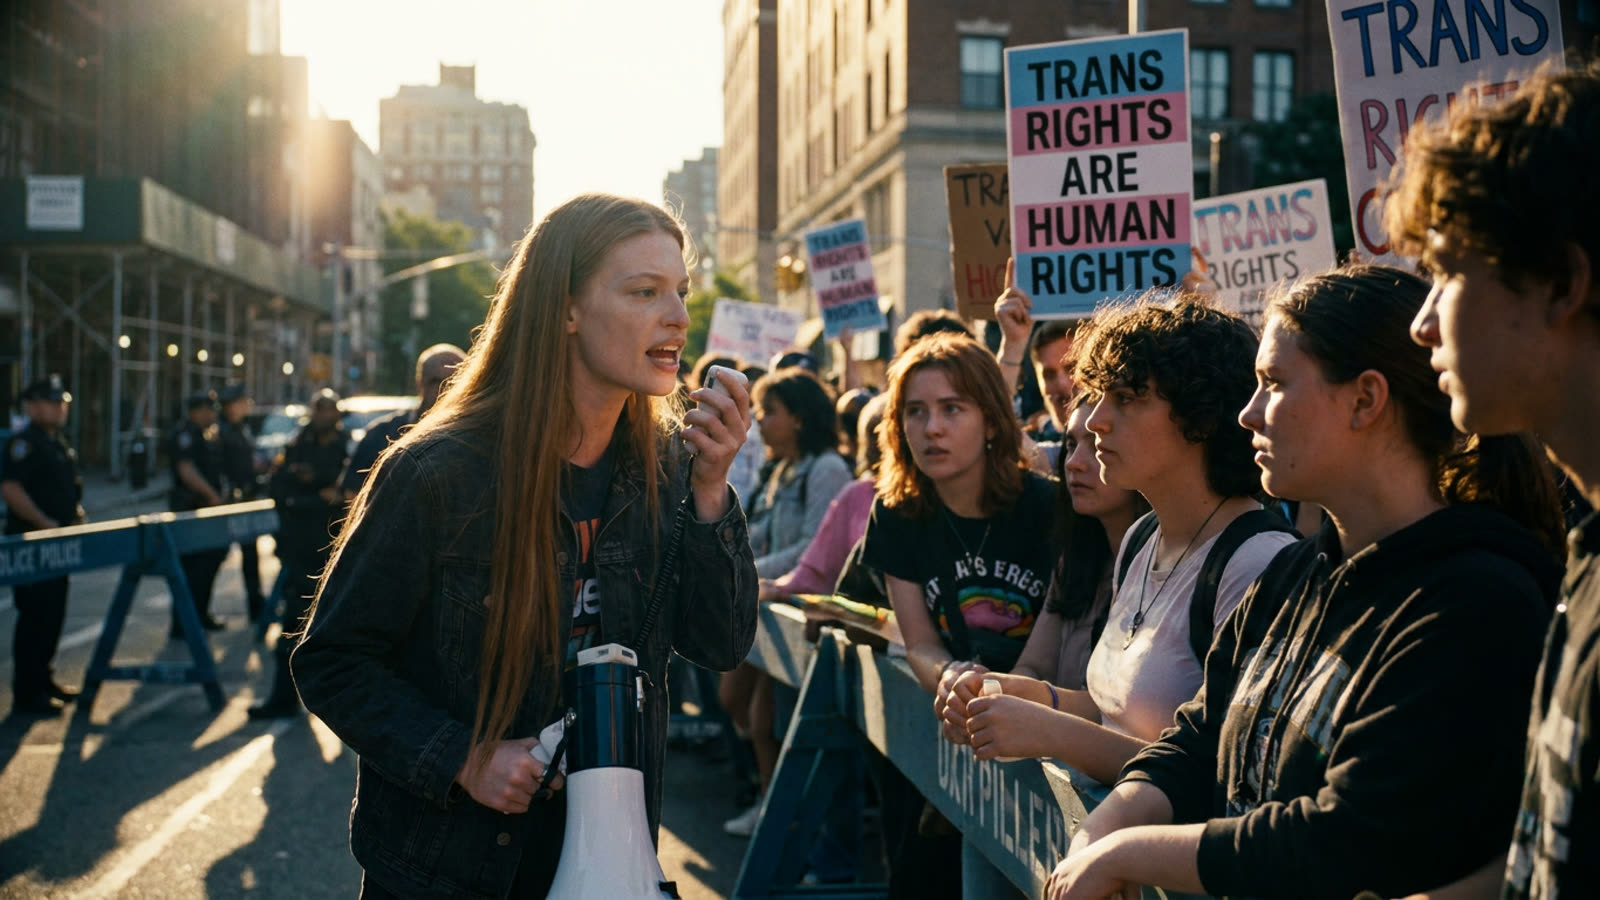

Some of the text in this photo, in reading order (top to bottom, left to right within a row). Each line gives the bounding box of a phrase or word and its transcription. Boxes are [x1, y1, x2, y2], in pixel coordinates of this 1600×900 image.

[1341, 0, 1549, 77] TRANS
[1027, 49, 1164, 102] TRANS
[1026, 98, 1172, 151] RIGHTS
[1060, 151, 1139, 197] ARE
[1028, 198, 1176, 248] HUMAN
[1193, 188, 1318, 257] TRANS
[1031, 247, 1177, 297] RIGHTS
